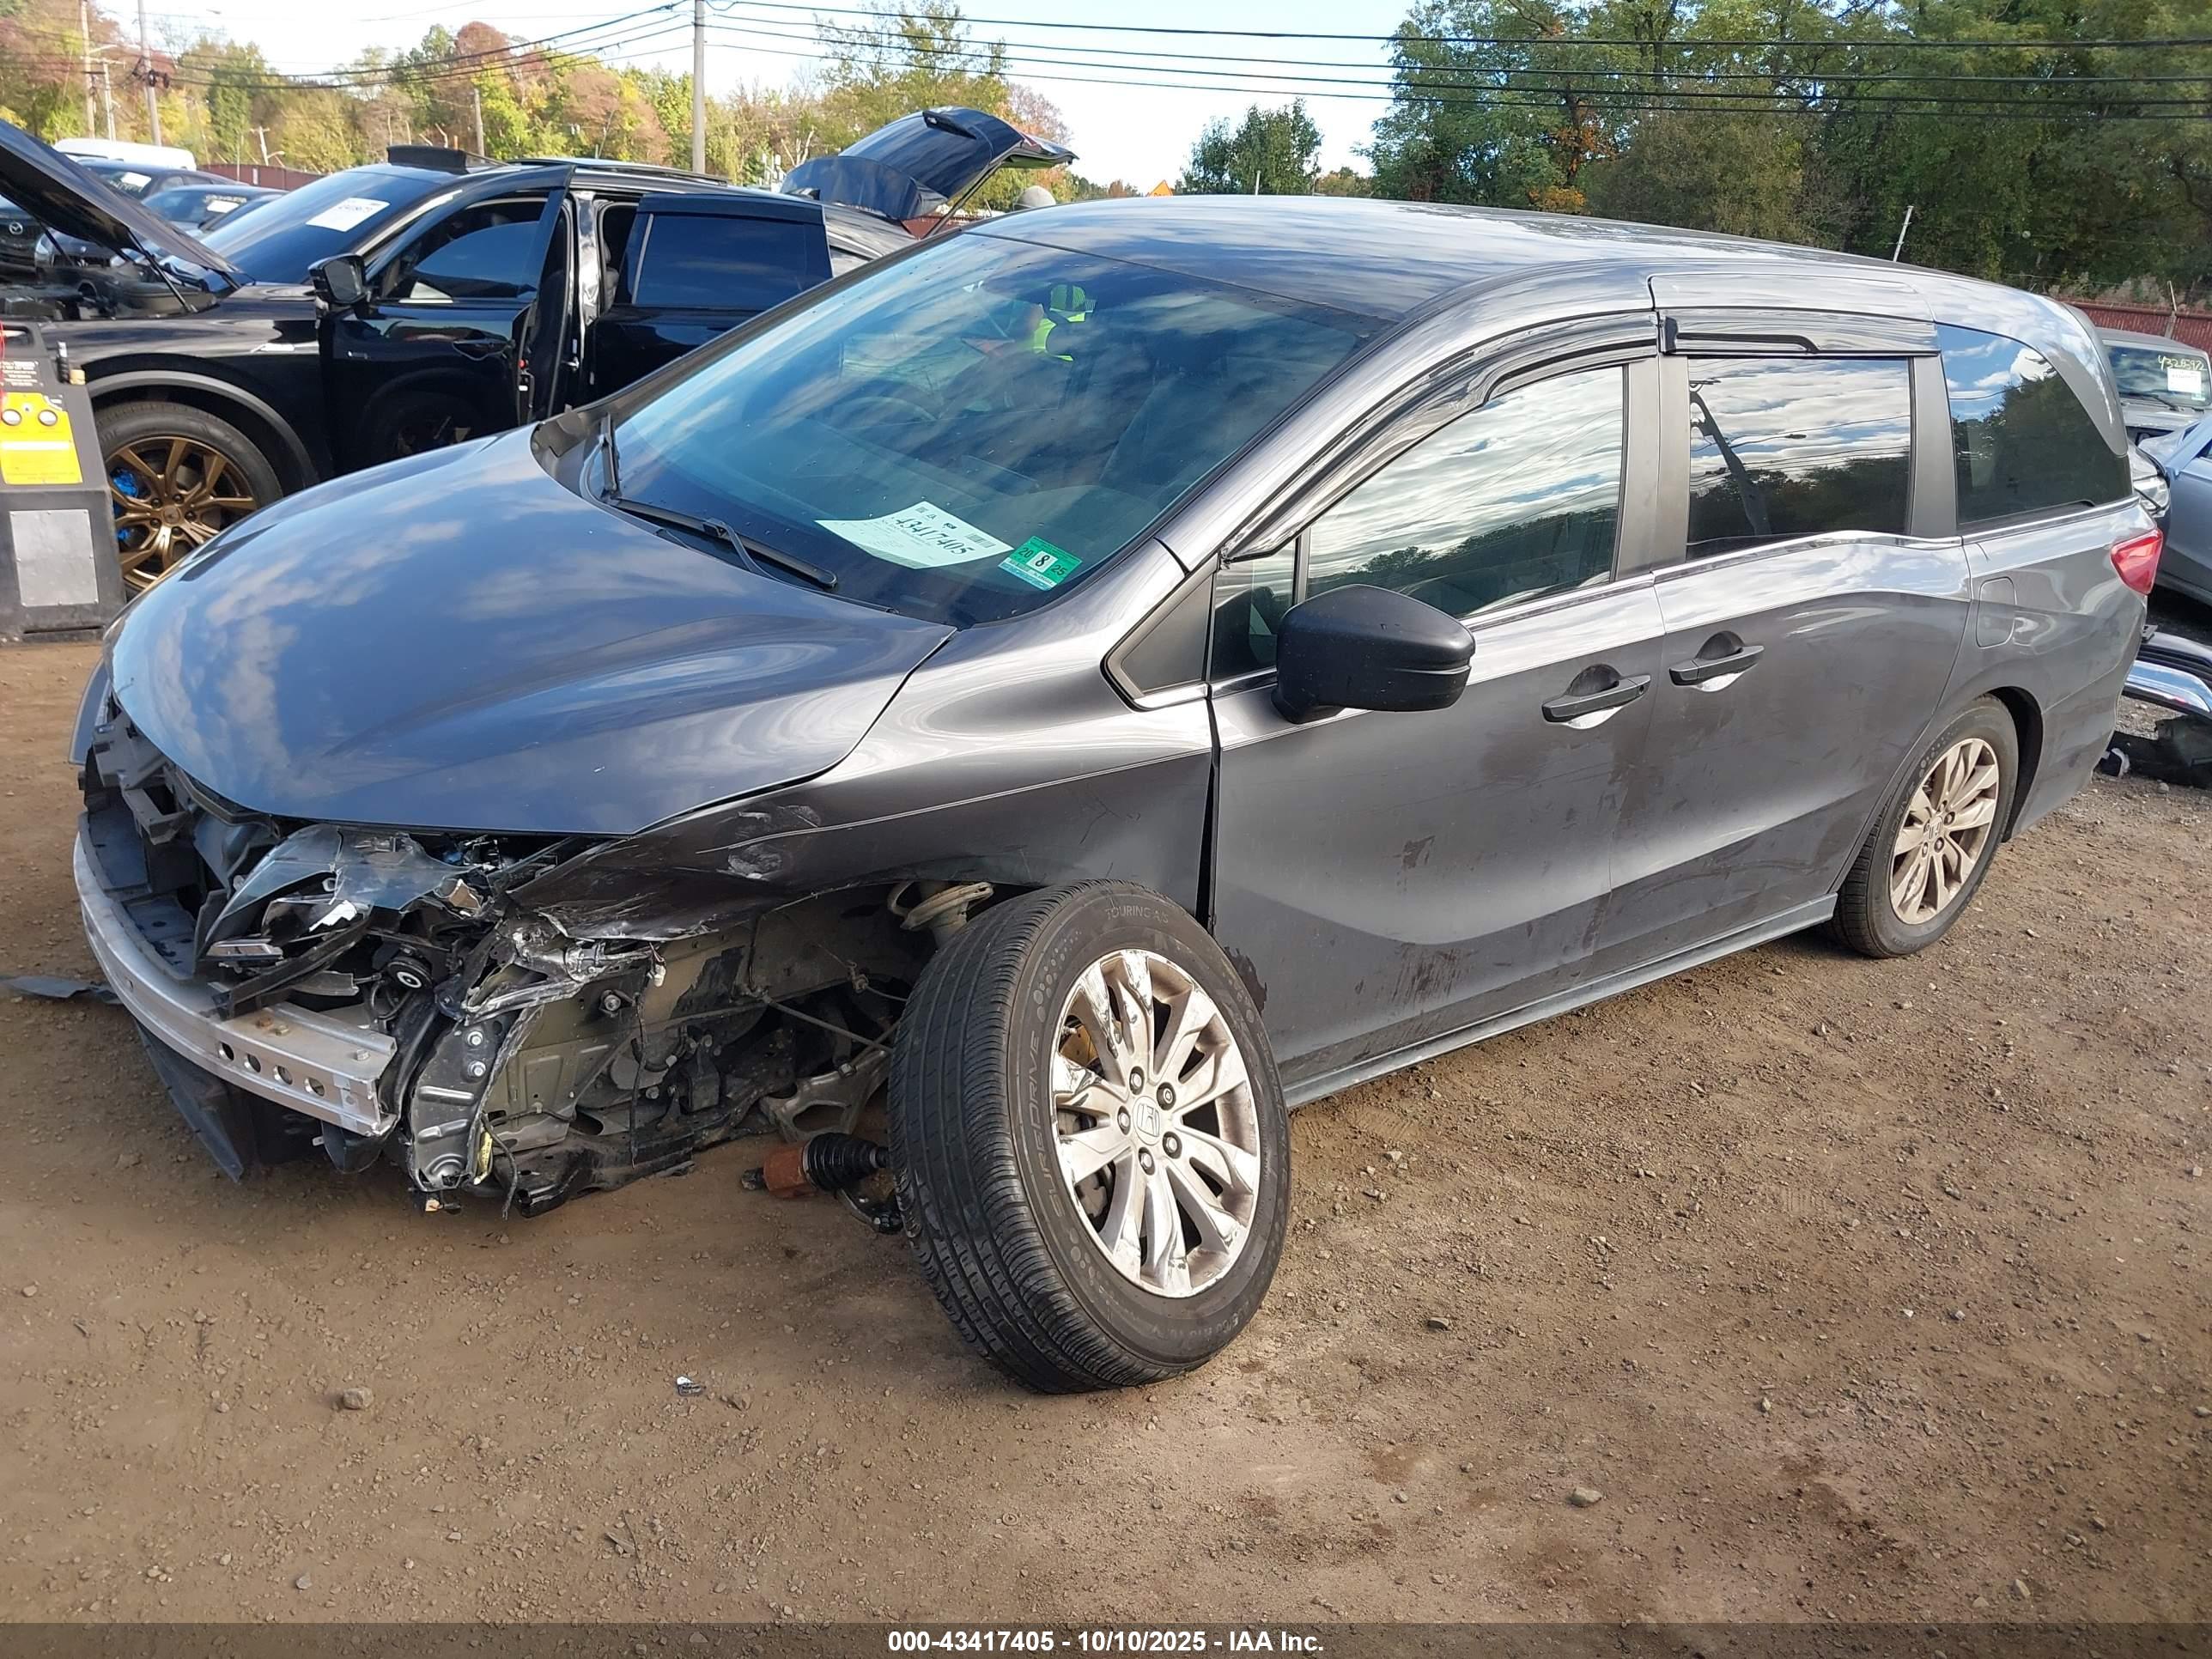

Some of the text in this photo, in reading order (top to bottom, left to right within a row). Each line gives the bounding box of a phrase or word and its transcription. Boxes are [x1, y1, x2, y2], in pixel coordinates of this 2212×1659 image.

[896, 518, 976, 554] 43417405
[1018, 547, 1034, 558] 20
[1035, 555, 1050, 567] 8
[1051, 564, 1066, 575] 25
[1104, 904, 1152, 921] TOURING
[1029, 1030, 1065, 1217] SUREDRIVE
